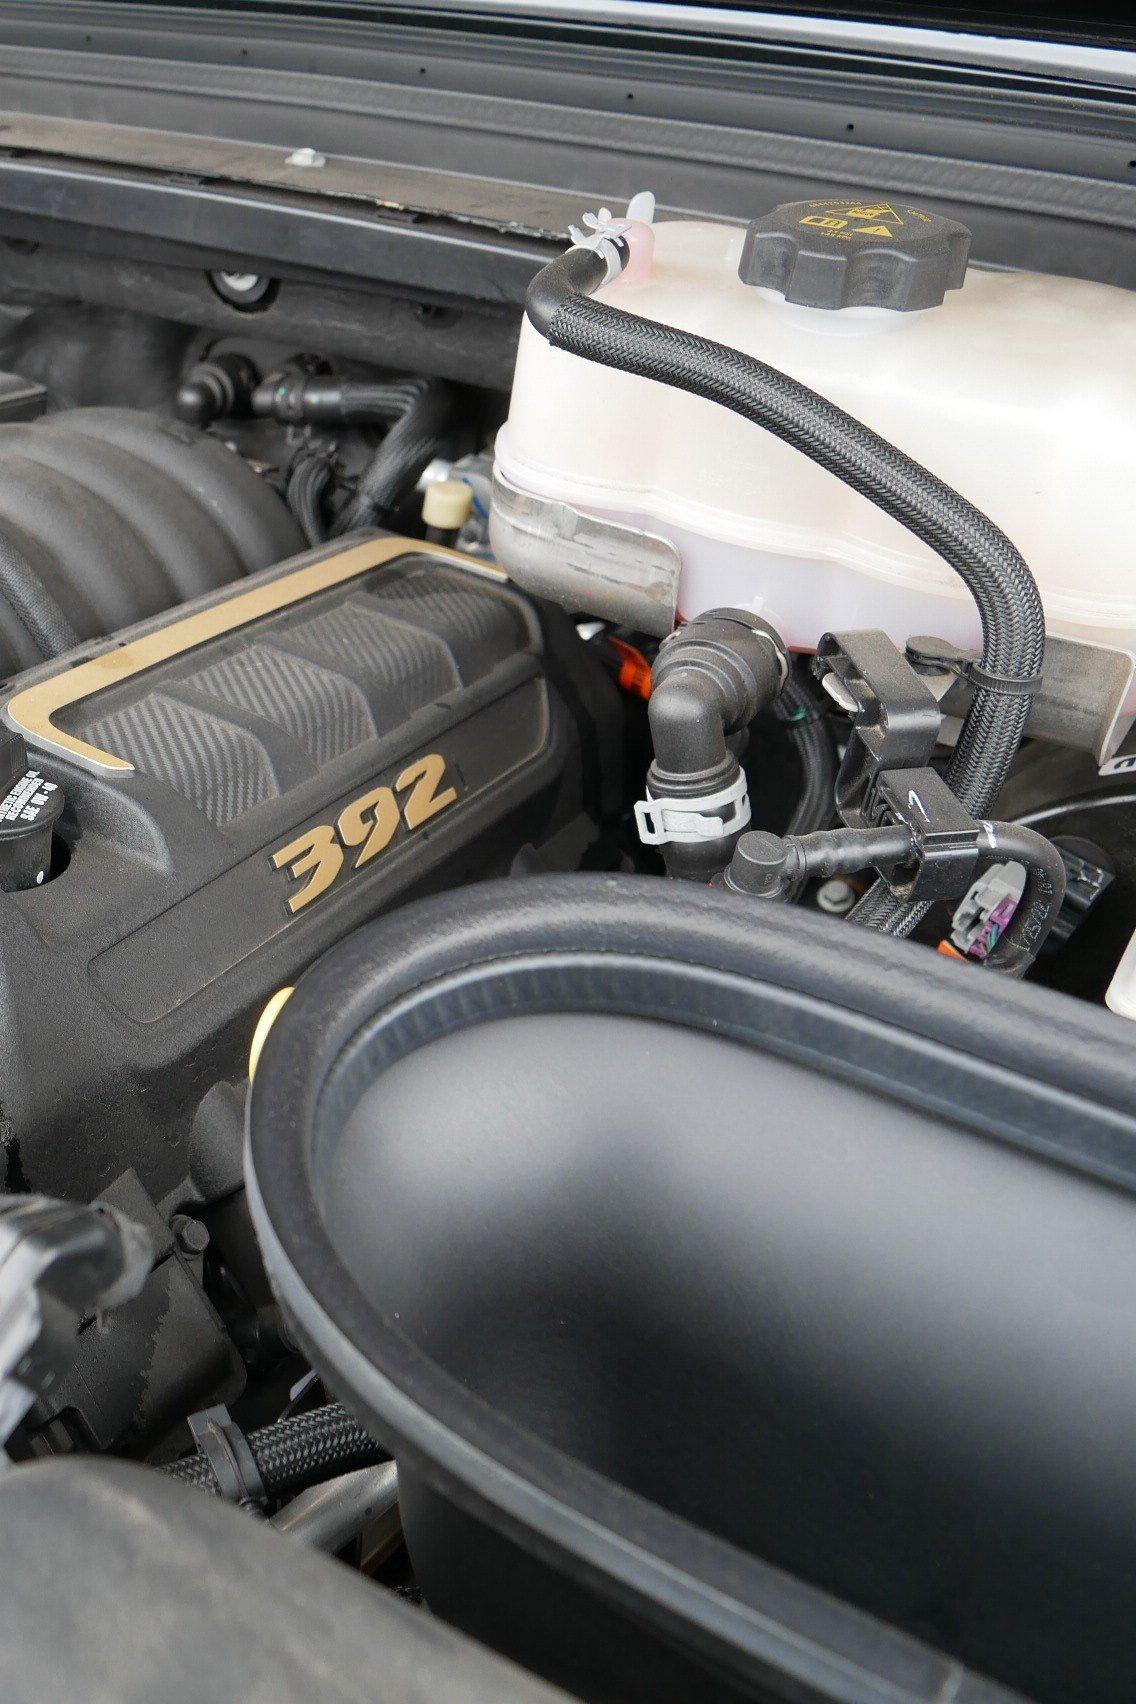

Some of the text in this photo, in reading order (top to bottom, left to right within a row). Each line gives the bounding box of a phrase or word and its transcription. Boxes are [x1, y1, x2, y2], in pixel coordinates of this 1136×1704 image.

[5, 777, 45, 821] RECOMMENDED
[20, 805, 41, 821] SAE
[271, 753, 458, 913] 392
